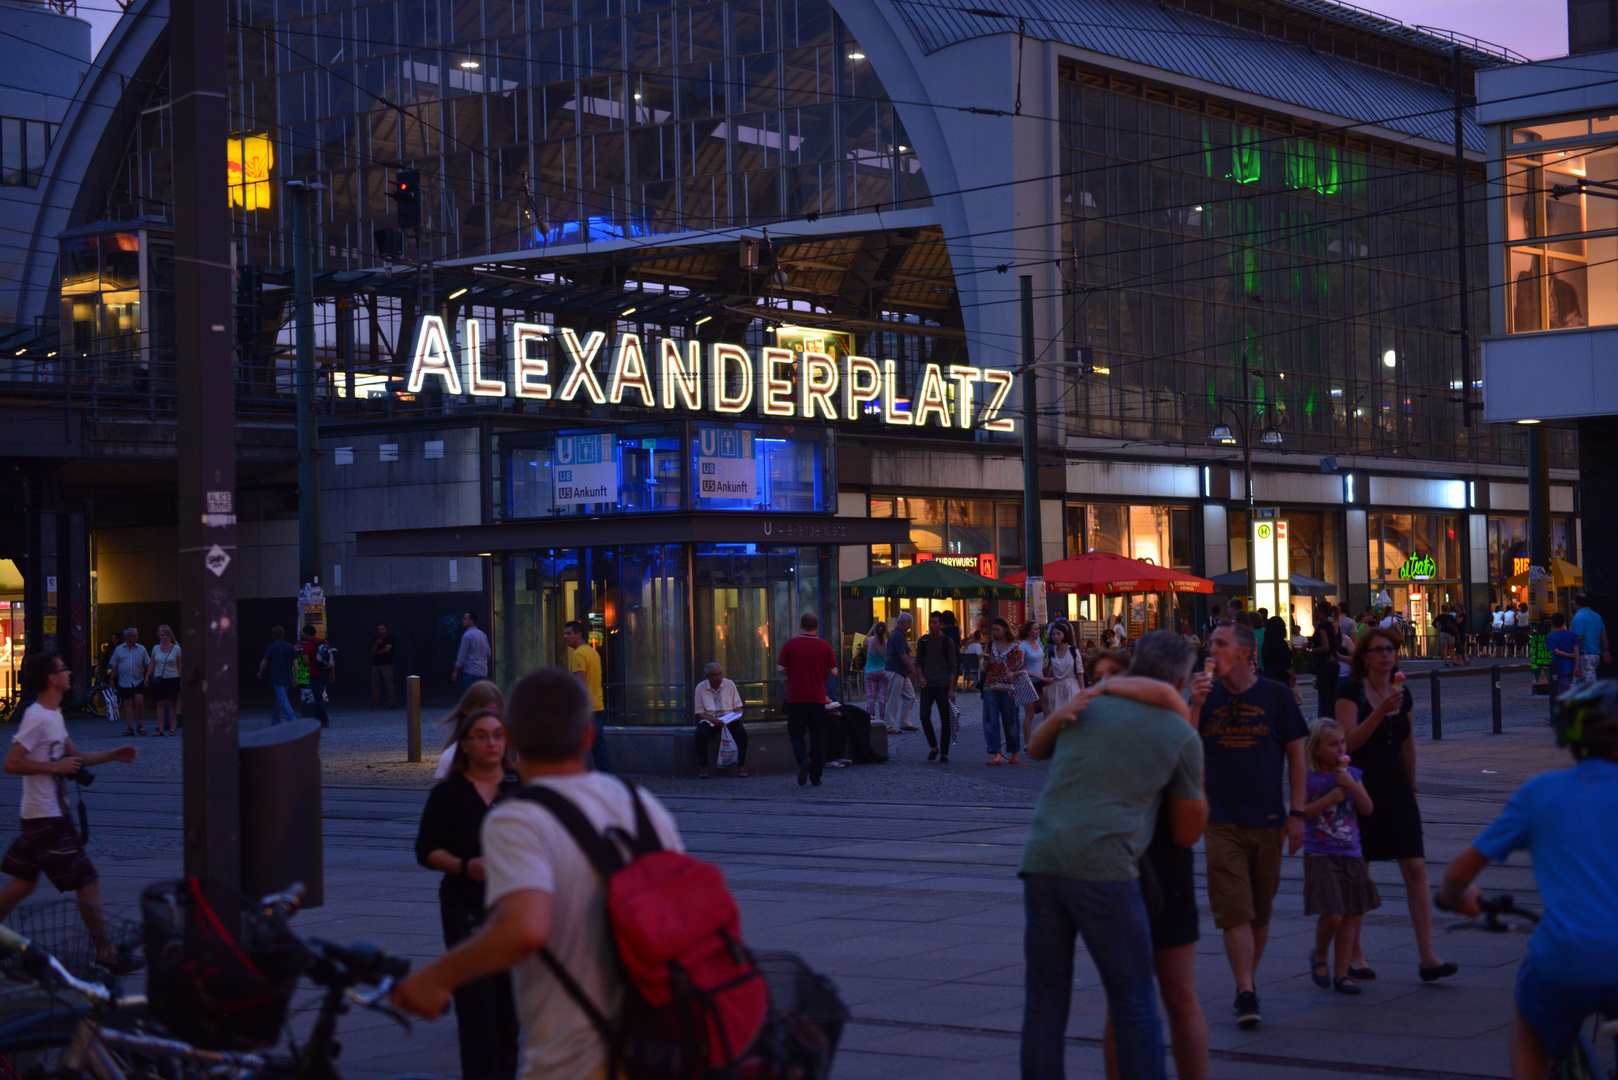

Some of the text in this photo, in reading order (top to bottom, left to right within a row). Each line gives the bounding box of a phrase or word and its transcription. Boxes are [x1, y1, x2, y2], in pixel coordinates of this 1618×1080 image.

[407, 315, 1015, 432] ALEXANDERPLATZ
[701, 430, 717, 456] U
[557, 438, 573, 465] U
[559, 471, 571, 481] U8
[703, 464, 714, 474] U8
[560, 485, 608, 498] U5 Ankunft
[703, 480, 748, 493] U5 Ankunft
[763, 521, 772, 536] U
[935, 556, 978, 568] CURRYWURST
[1513, 557, 1531, 577] RIE
